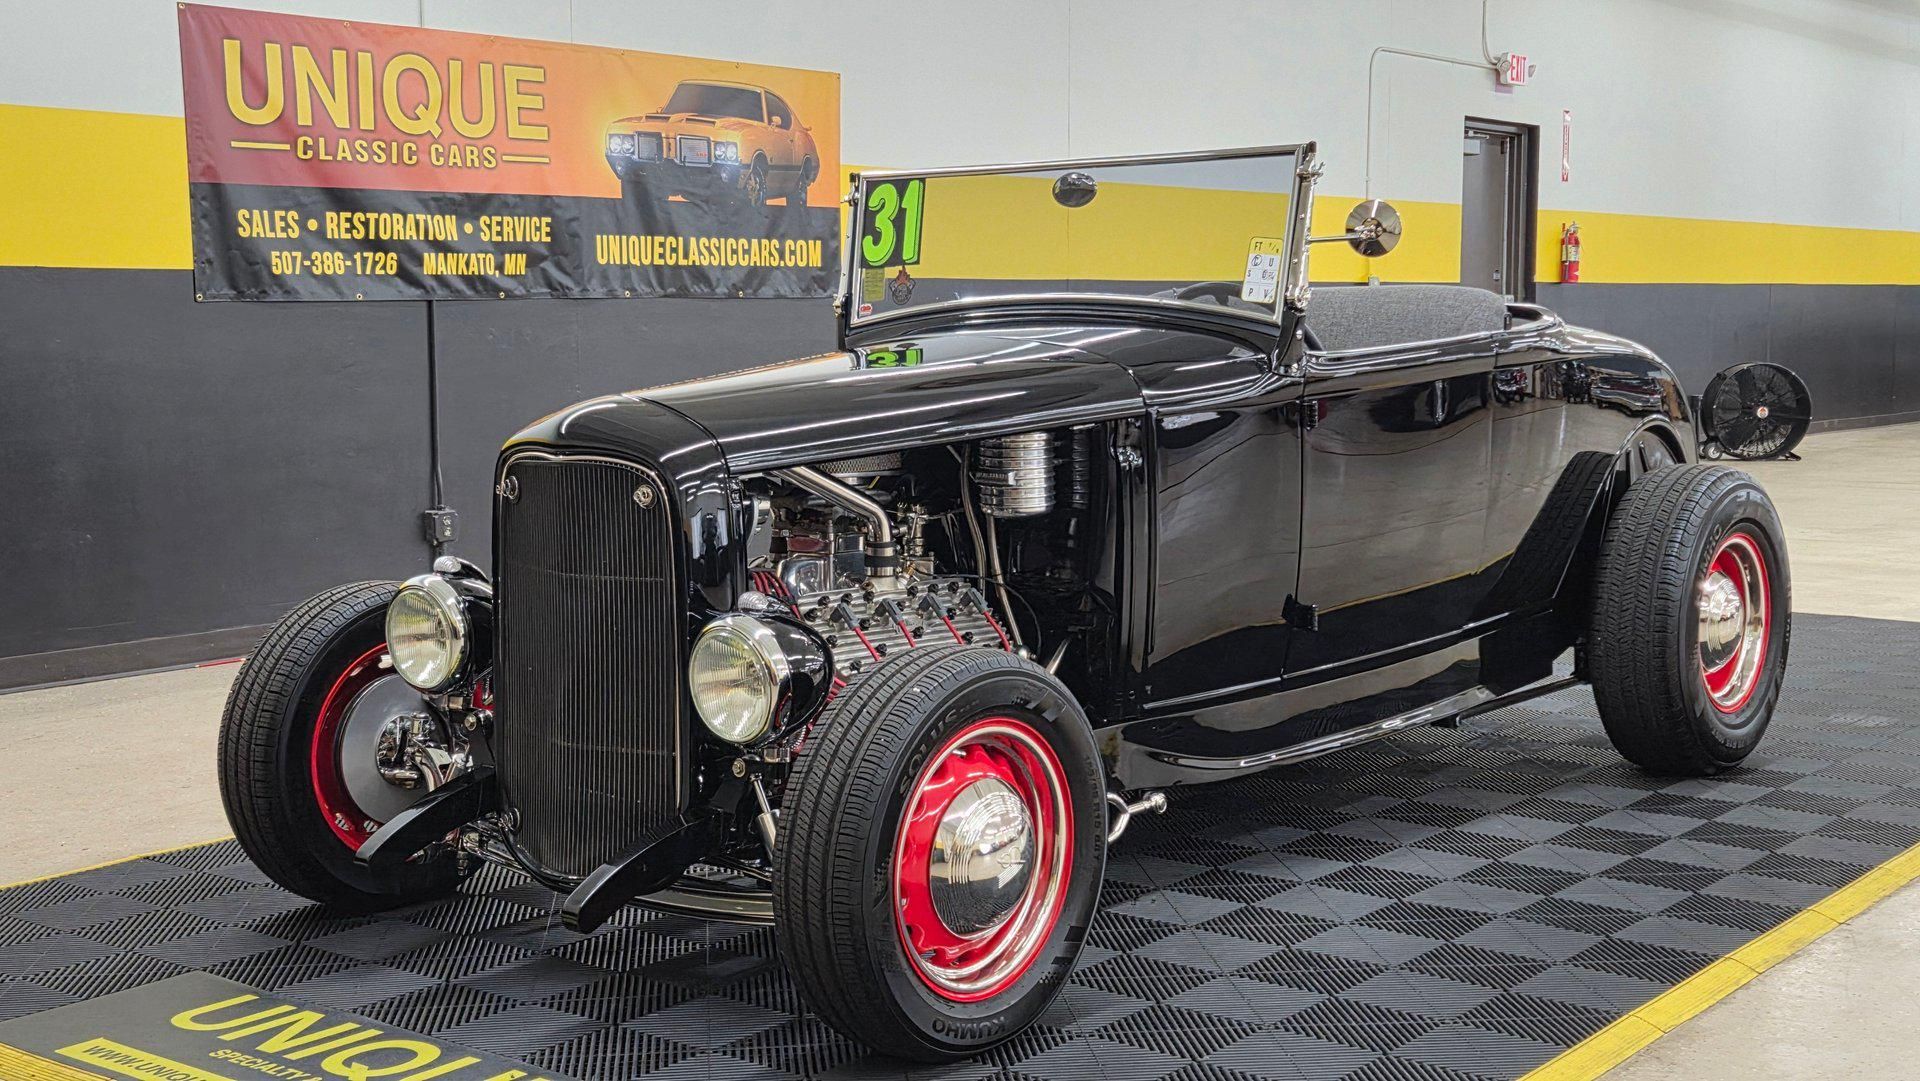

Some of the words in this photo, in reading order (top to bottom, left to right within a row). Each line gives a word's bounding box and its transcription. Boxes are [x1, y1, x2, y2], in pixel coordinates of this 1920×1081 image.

[1510, 53, 1527, 83] EXIT
[223, 38, 549, 139] UNIQUE
[297, 135, 418, 165] CLASSIC
[430, 145, 497, 168] CARS
[237, 208, 300, 239] SALES
[325, 211, 458, 241] RESTORATION
[479, 215, 552, 242] SERVICE
[863, 179, 924, 266] 31
[271, 251, 398, 276] 507-386-1726
[423, 252, 500, 278] MANKATO,
[504, 253, 527, 276] MN
[596, 235, 822, 267] UNIQUECLASSICCARS.COM
[931, 1015, 1007, 1040] KUMHO
[208, 1048, 311, 1080] SPECIALTY
